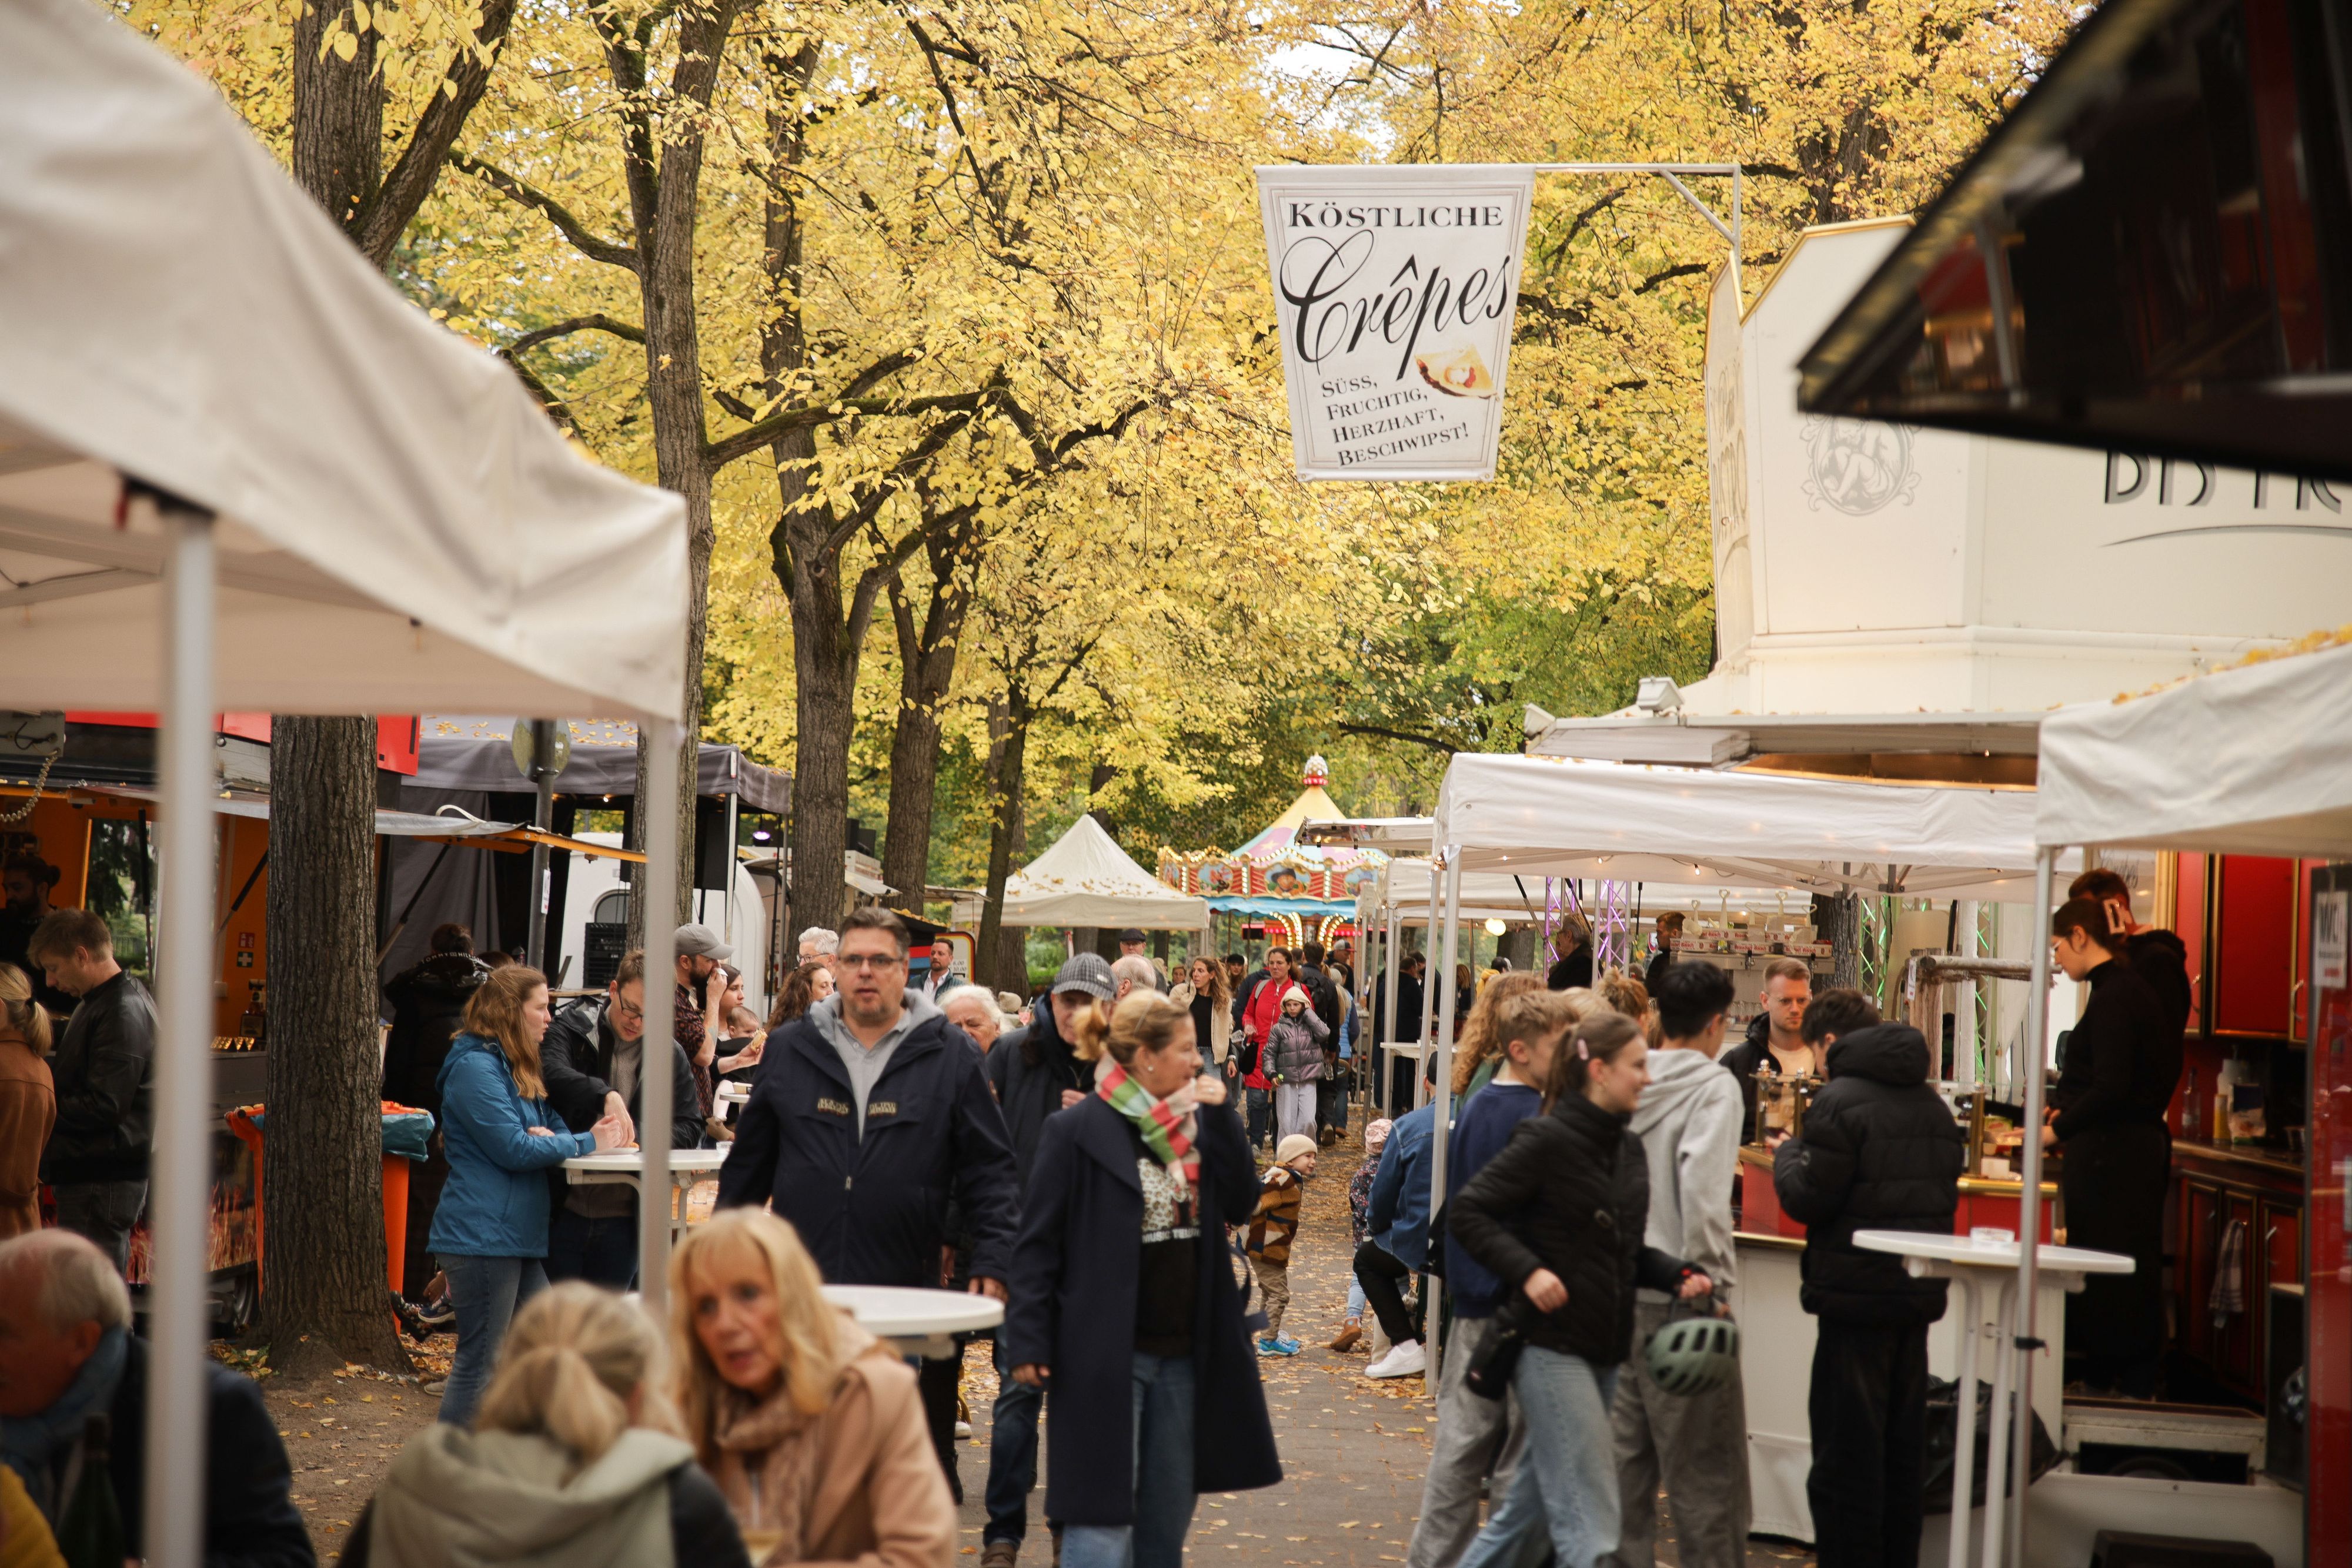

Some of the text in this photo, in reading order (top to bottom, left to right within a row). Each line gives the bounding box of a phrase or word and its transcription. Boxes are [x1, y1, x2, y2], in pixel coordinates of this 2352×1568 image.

[1289, 202, 1504, 228] KÖSTLICHE
[1279, 229, 1511, 381] Crêpes
[1321, 375, 1378, 399] SÜSS,
[1326, 388, 1428, 420] FRUCHTIG,
[1332, 408, 1445, 443] HERZHAFT,
[1337, 422, 1469, 466] BESCHWIPST!
[421, 953, 449, 964] TOMMY
